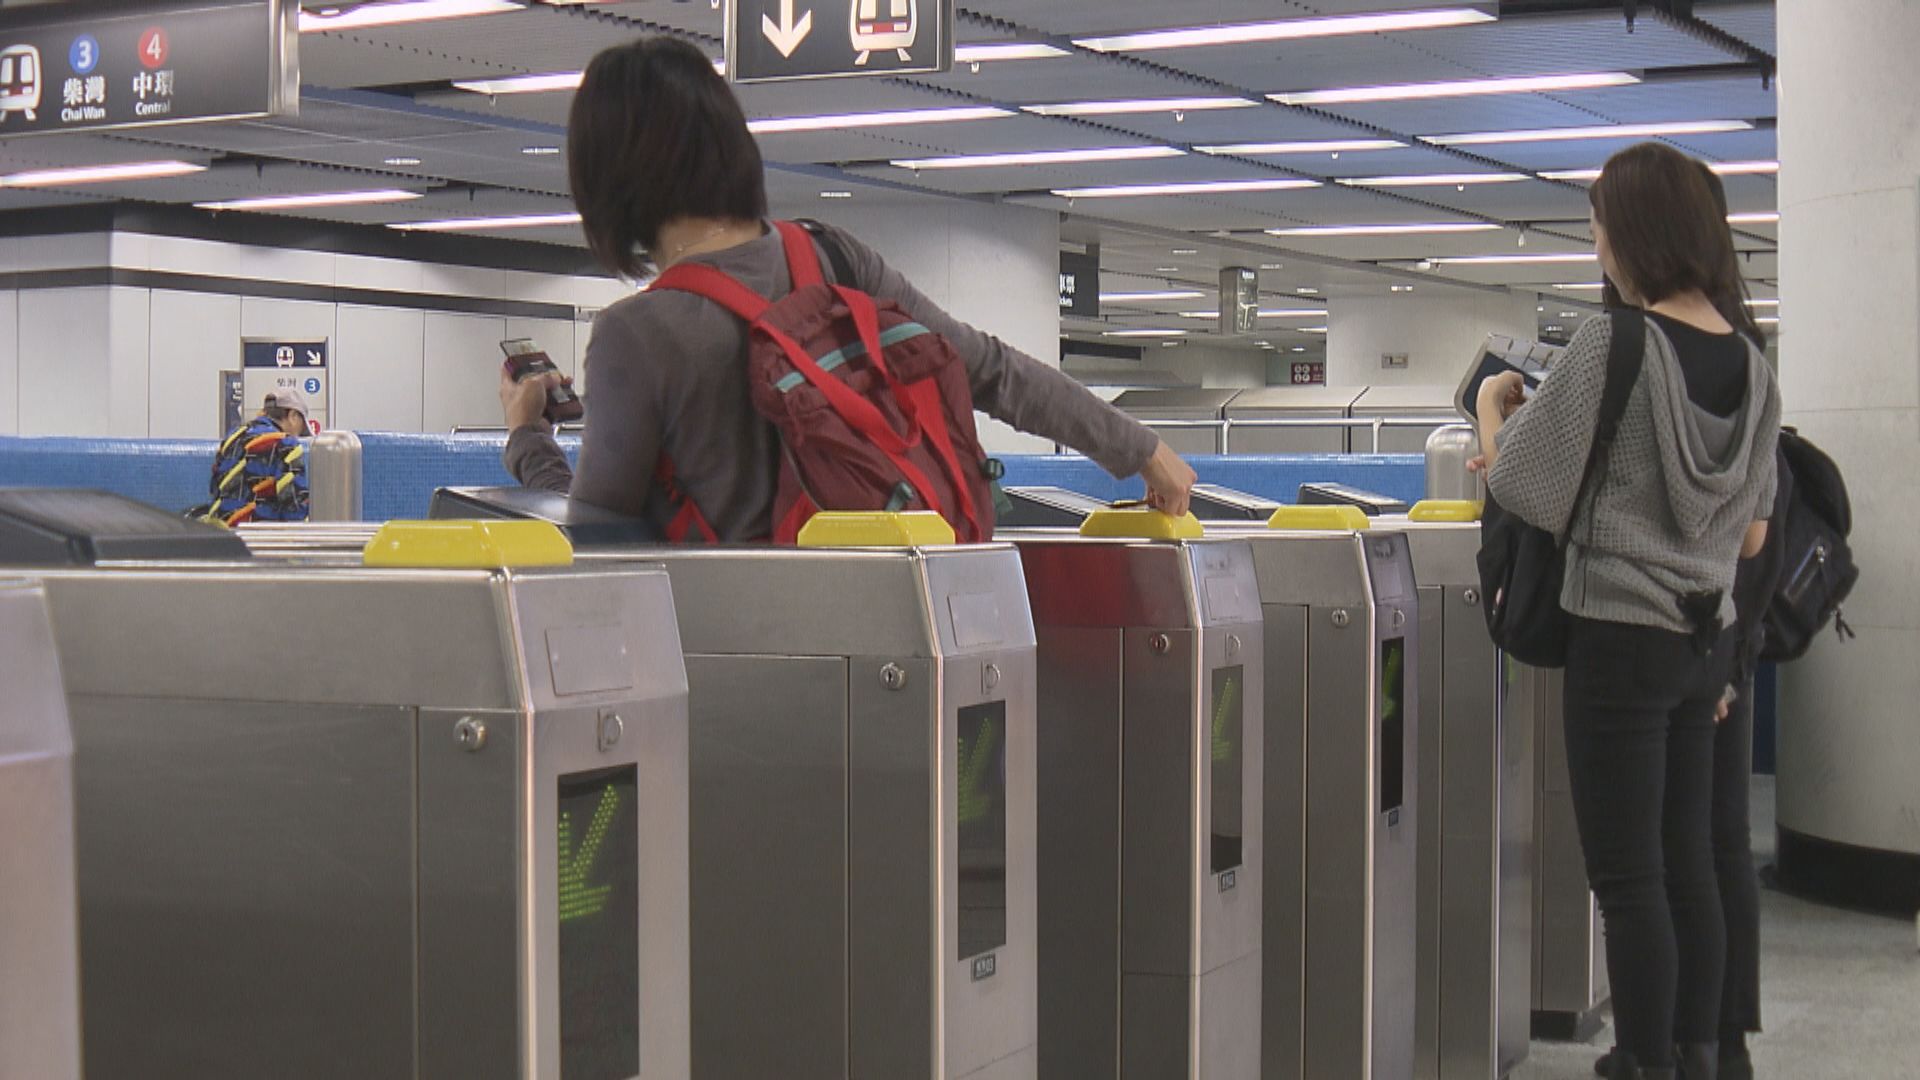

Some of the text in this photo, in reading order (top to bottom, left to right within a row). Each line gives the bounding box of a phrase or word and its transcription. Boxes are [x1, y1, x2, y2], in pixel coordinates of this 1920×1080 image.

[77, 40, 92, 68] 3
[146, 34, 161, 60] 4
[63, 76, 105, 105] 柴灣
[132, 70, 173, 99] 中環
[61, 106, 105, 121] Chai Wan
[135, 99, 170, 115] Central
[308, 380, 316, 391] 3
